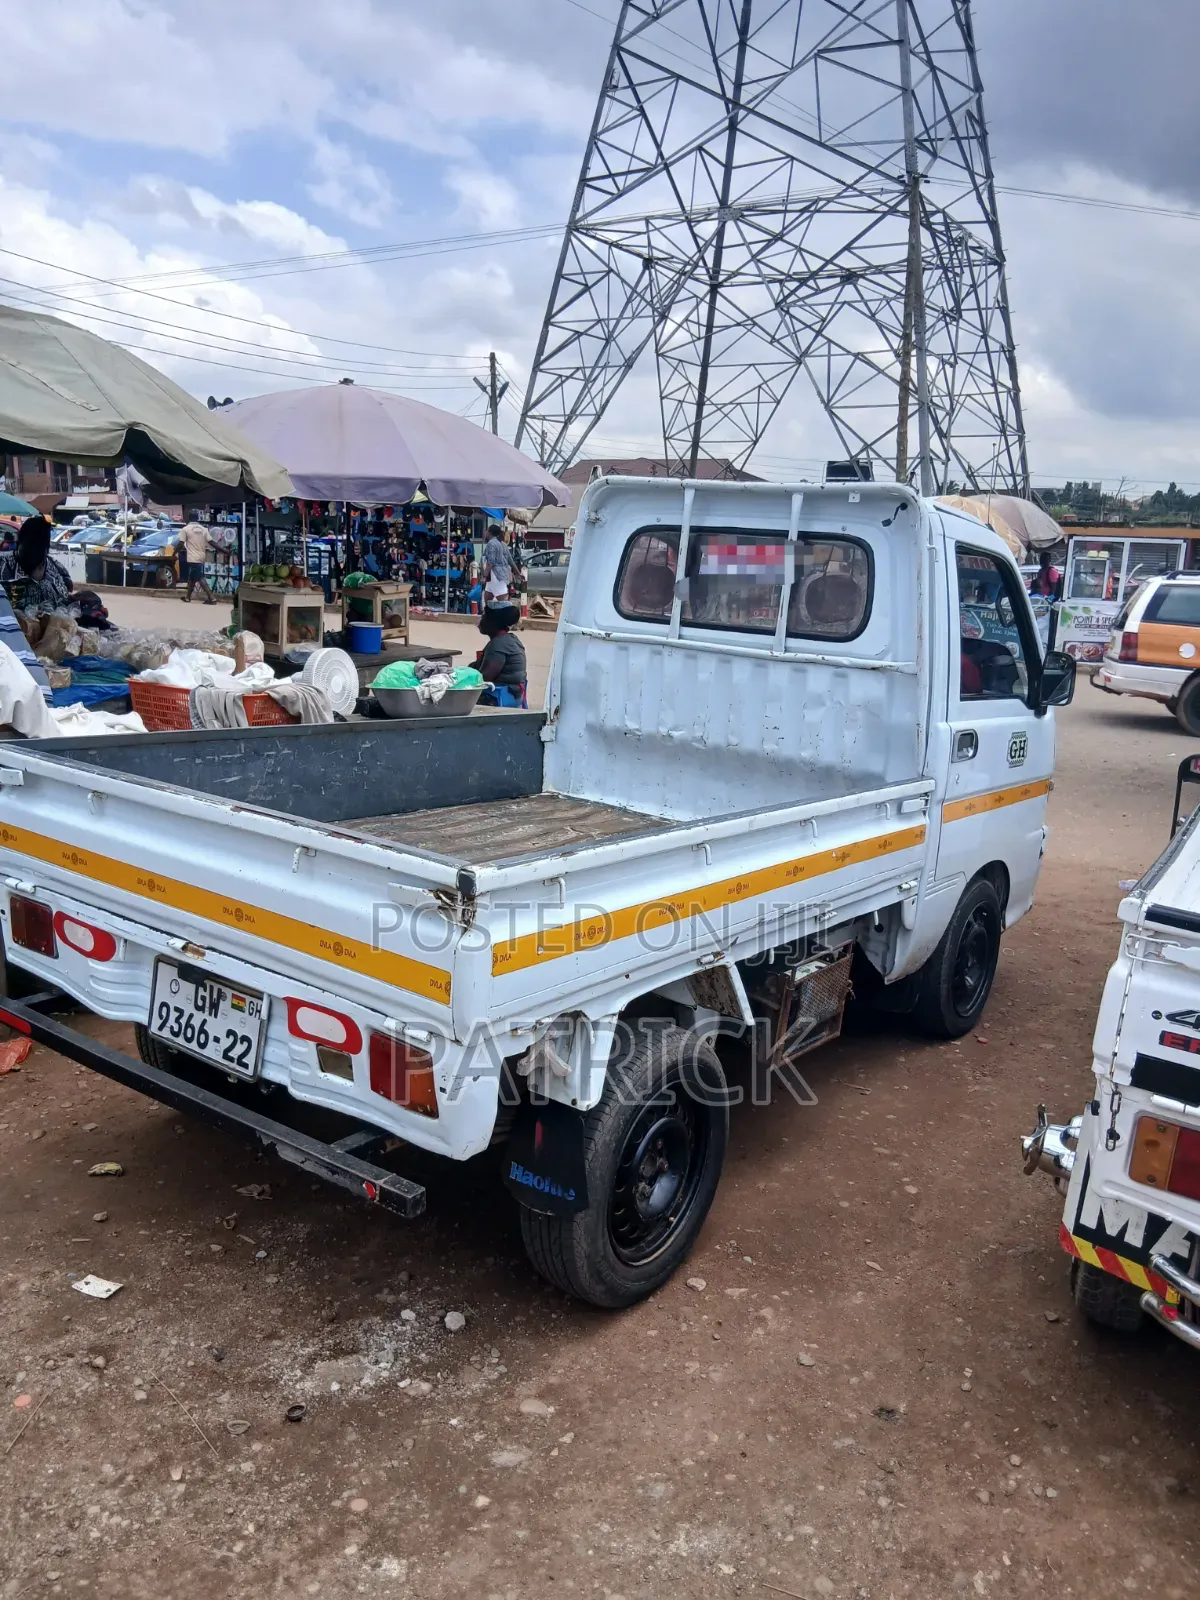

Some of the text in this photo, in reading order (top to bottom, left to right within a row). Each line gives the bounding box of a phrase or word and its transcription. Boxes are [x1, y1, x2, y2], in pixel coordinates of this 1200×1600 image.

[1073, 616, 1093, 625] POINT
[1010, 740, 1027, 760] GH
[156, 884, 167, 893] DVLA
[222, 906, 234, 917] DVLA
[244, 914, 256, 924] DVLA
[319, 939, 332, 951] DVLA
[344, 948, 357, 959] DVLA
[429, 978, 443, 991] DVLA
[499, 953, 512, 964] DVLA
[575, 932, 587, 942] DVLA
[194, 983, 222, 1019] GW
[248, 1000, 263, 1021] GH
[157, 1001, 253, 1070] 9366-22
